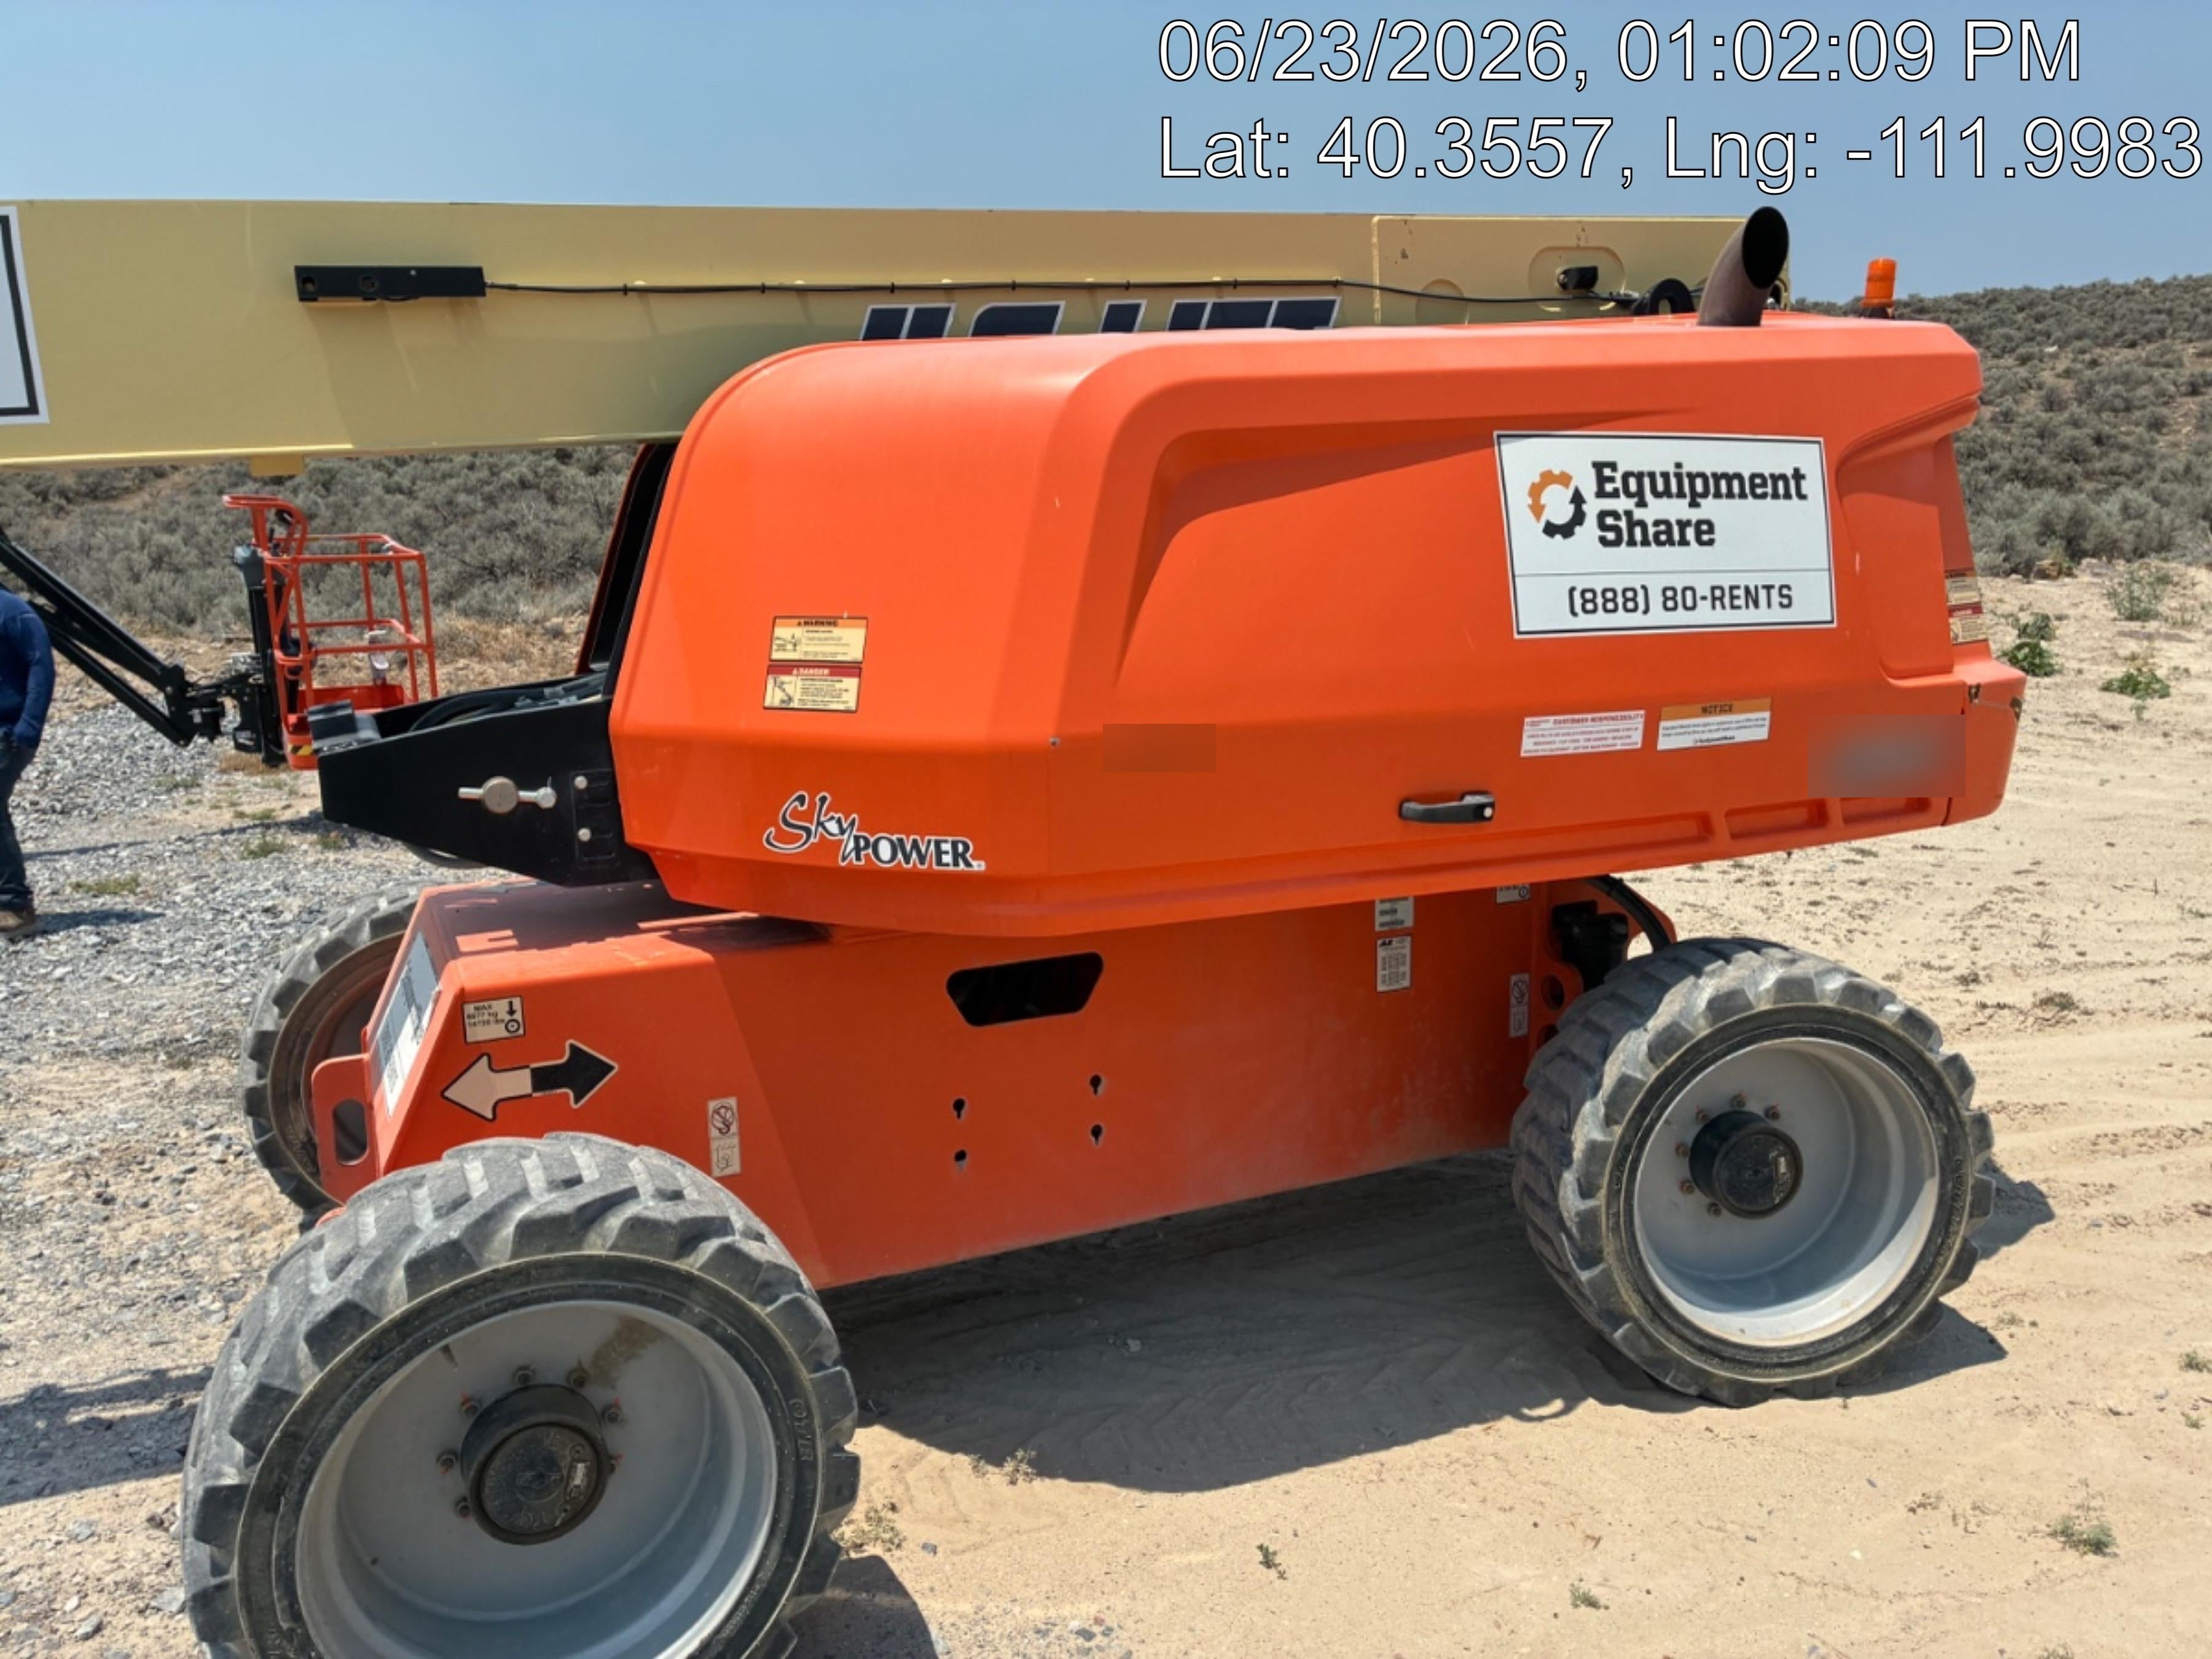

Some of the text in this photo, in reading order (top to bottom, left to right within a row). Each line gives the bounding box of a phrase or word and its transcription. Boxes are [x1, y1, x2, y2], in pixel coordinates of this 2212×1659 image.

[1591, 460, 1808, 509] Equipment
[1596, 510, 1716, 548] Share
[1568, 584, 1793, 617] (888) 80-RENTS
